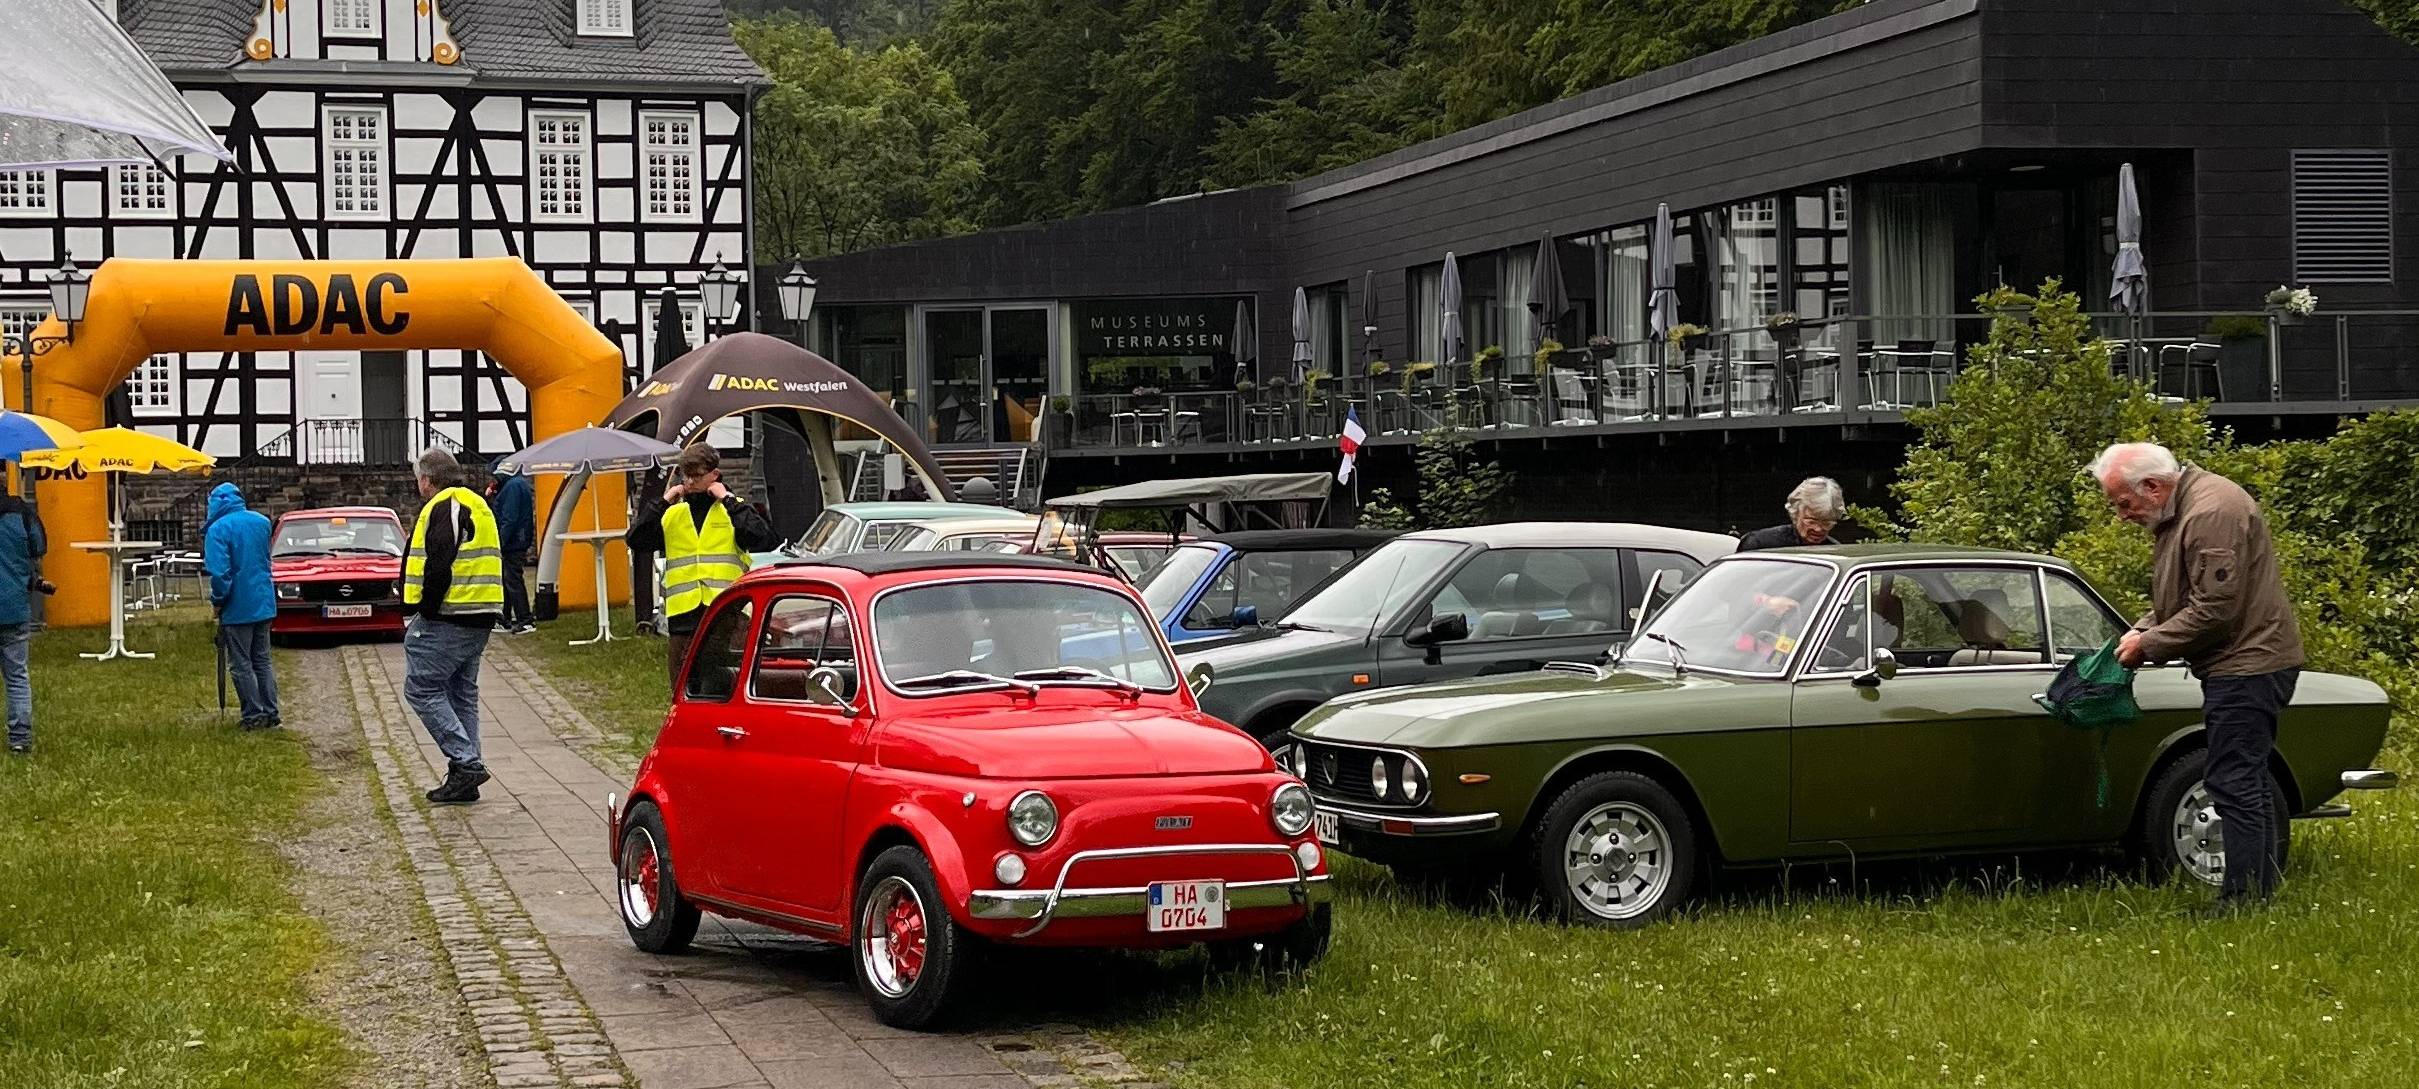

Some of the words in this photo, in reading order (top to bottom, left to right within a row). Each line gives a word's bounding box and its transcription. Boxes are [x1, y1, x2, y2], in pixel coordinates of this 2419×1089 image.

[224, 273, 410, 336] ADAC
[1091, 314, 1206, 329] MUSEUMS
[1104, 334, 1223, 348] TERRASSEN
[726, 376, 780, 391] ADAC
[784, 381, 848, 394] Westfalen
[22, 458, 88, 481] DAC
[99, 457, 134, 468] ADAC
[1174, 884, 1198, 905] HA
[1161, 907, 1207, 928] 0704
